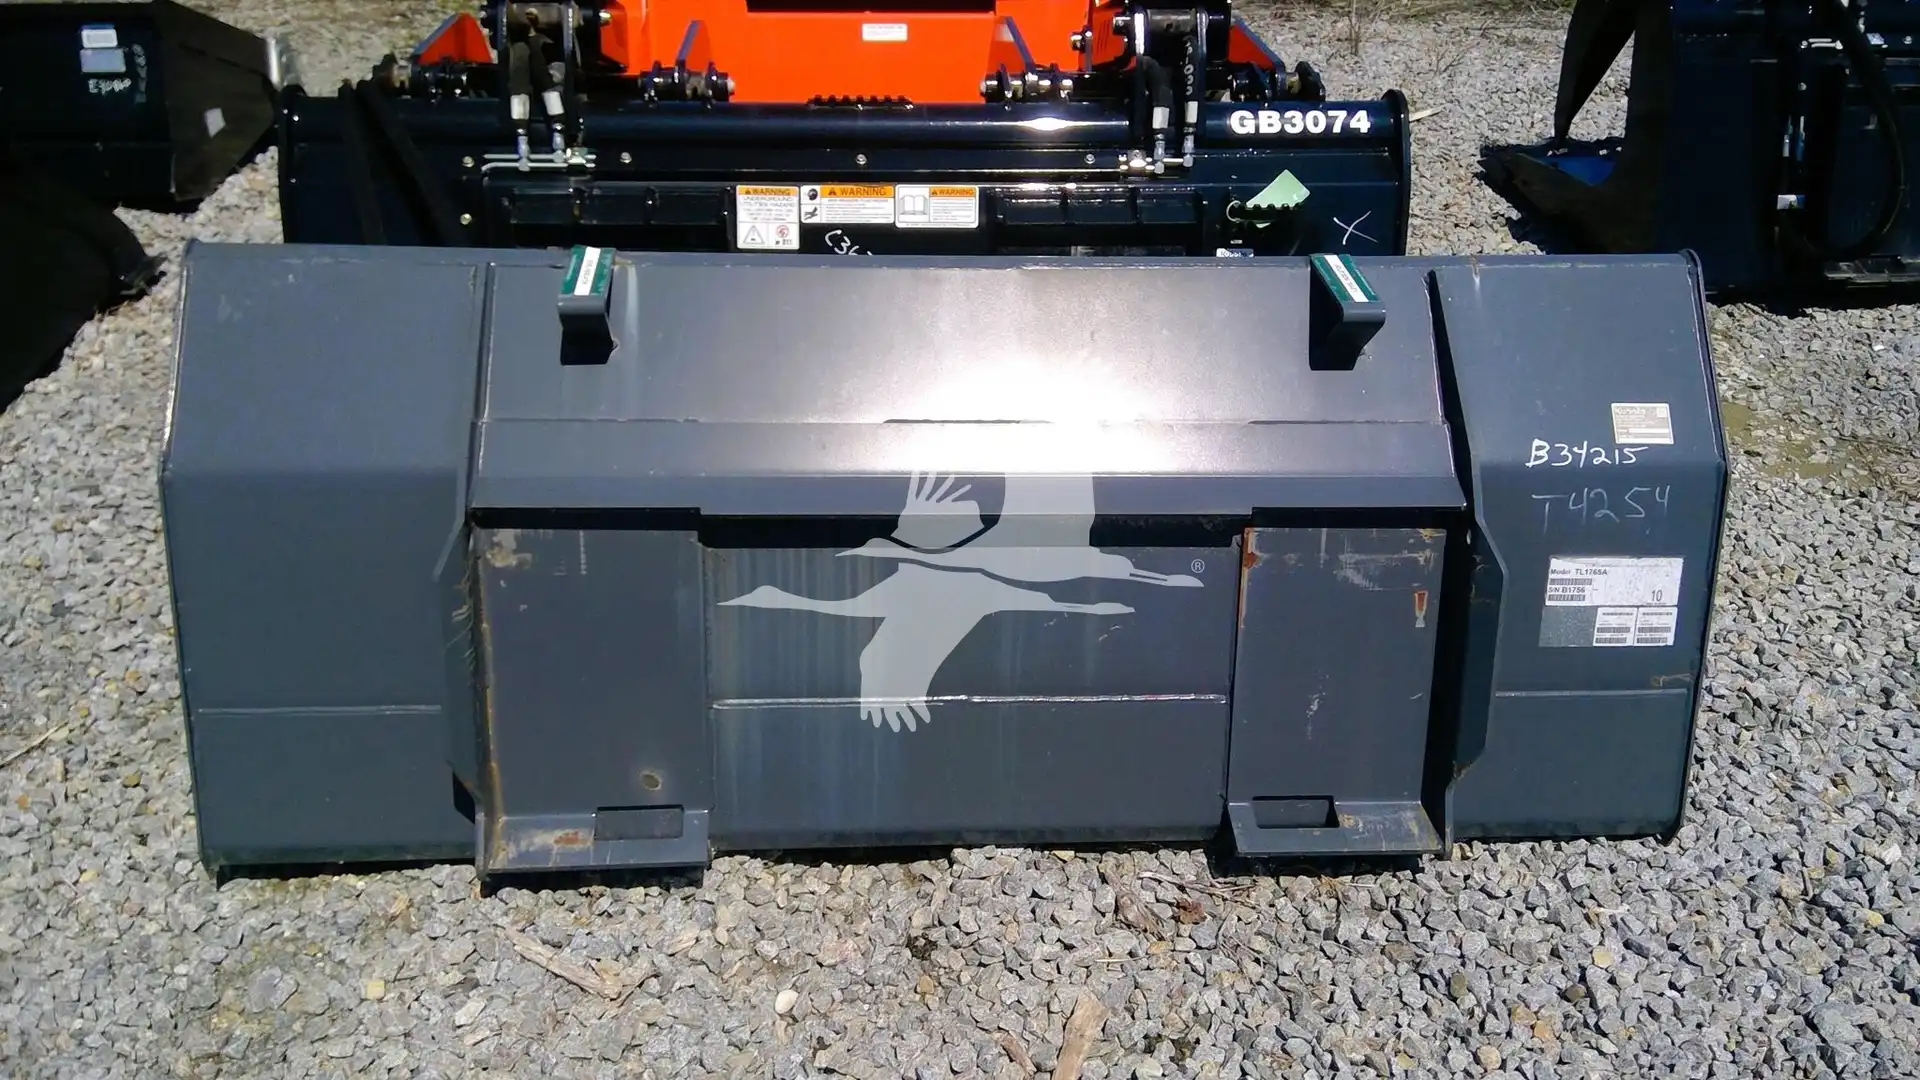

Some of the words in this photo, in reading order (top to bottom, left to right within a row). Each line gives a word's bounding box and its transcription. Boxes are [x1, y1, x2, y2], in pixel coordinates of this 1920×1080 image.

[1230, 110, 1371, 134] GB3074
[753, 188, 791, 196] WARNING
[840, 187, 887, 196] WARNING
[939, 188, 974, 196] WARNING
[1525, 438, 1649, 468] B34215
[1574, 568, 1608, 576] TL1765A
[1561, 586, 1586, 594] B1756
[1651, 588, 1663, 602] 10
